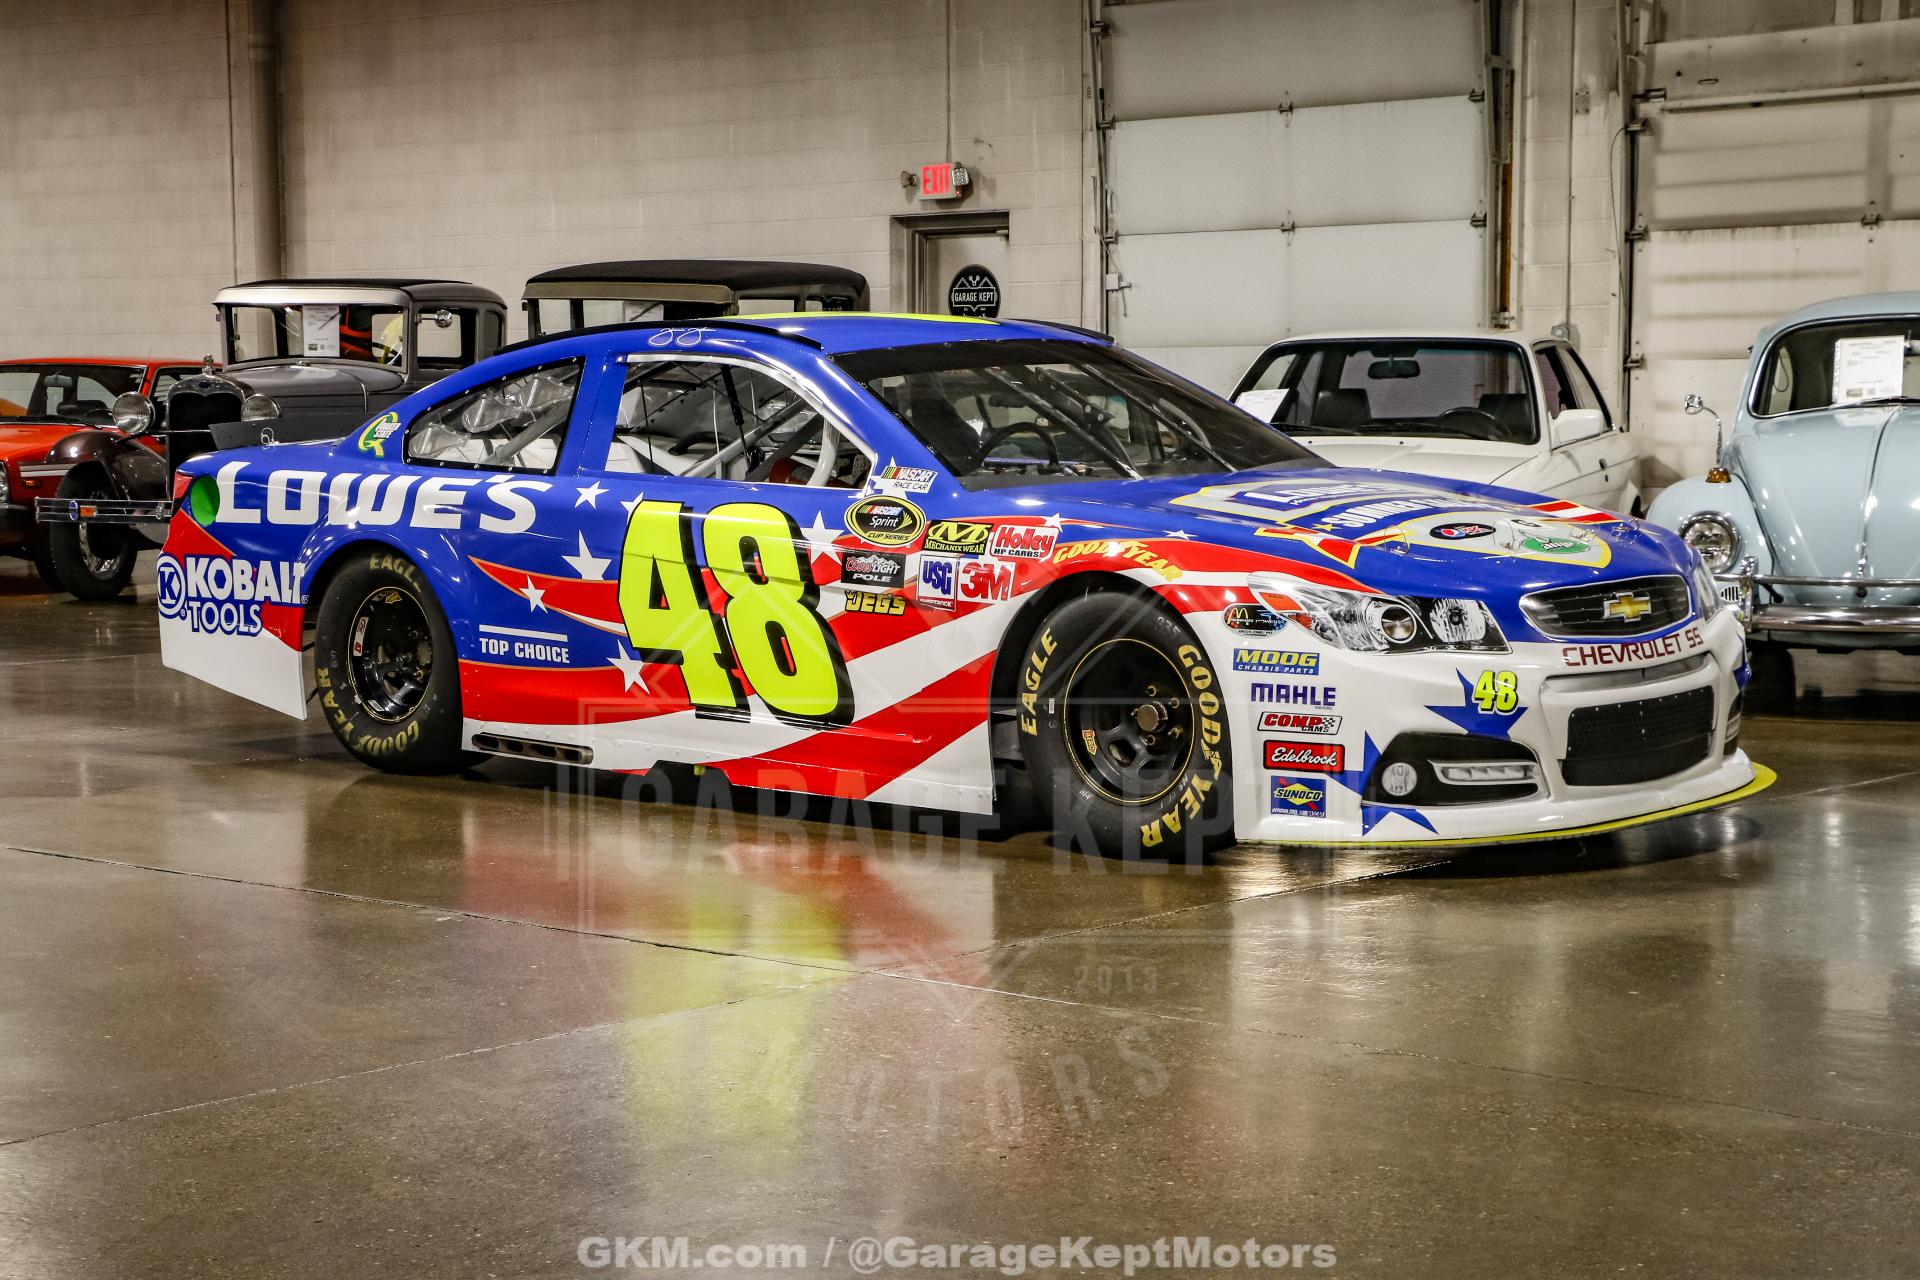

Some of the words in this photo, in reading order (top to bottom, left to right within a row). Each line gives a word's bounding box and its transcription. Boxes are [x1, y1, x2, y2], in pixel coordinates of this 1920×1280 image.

[922, 164, 950, 194] EXIT
[954, 292, 977, 302] GARAGE
[979, 292, 994, 302] KEPT
[897, 466, 934, 482] NASCAR
[894, 481, 912, 490] RACE
[913, 482, 929, 491] CAR
[215, 461, 554, 534] LOWE'S
[871, 505, 904, 516] NASCAR
[870, 516, 899, 528] Sprint
[867, 532, 884, 540] CUP
[884, 533, 911, 541] SERIES
[995, 527, 1055, 553] Holley
[923, 539, 962, 552] MECHANIX
[962, 544, 985, 554] WEAR
[1008, 550, 1039, 558] CARBS
[871, 560, 901, 575] LIGHT
[186, 556, 306, 604] KOBALT
[852, 573, 892, 582] POLE
[923, 560, 953, 596] USG
[960, 562, 1012, 601] 3M
[189, 601, 262, 634] TOOLS
[618, 499, 855, 730] 48
[479, 637, 510, 656] TOP
[514, 642, 570, 664] CHOICE
[1561, 633, 1681, 667] CHEVROLET
[1684, 627, 1704, 649] SS
[1236, 649, 1318, 667] MOOG
[1238, 664, 1280, 673] CHASSIS
[1283, 666, 1314, 674] PARTS
[1020, 626, 1058, 736] EAGLE
[1251, 683, 1336, 707] MAHLE
[1474, 670, 1519, 713] 48
[1264, 713, 1323, 728] COMP
[1301, 725, 1330, 733] CAMS
[1140, 644, 1224, 848] GOODYEAR
[1271, 747, 1337, 766] Edelbrock
[1275, 787, 1323, 800] SUNOCO
